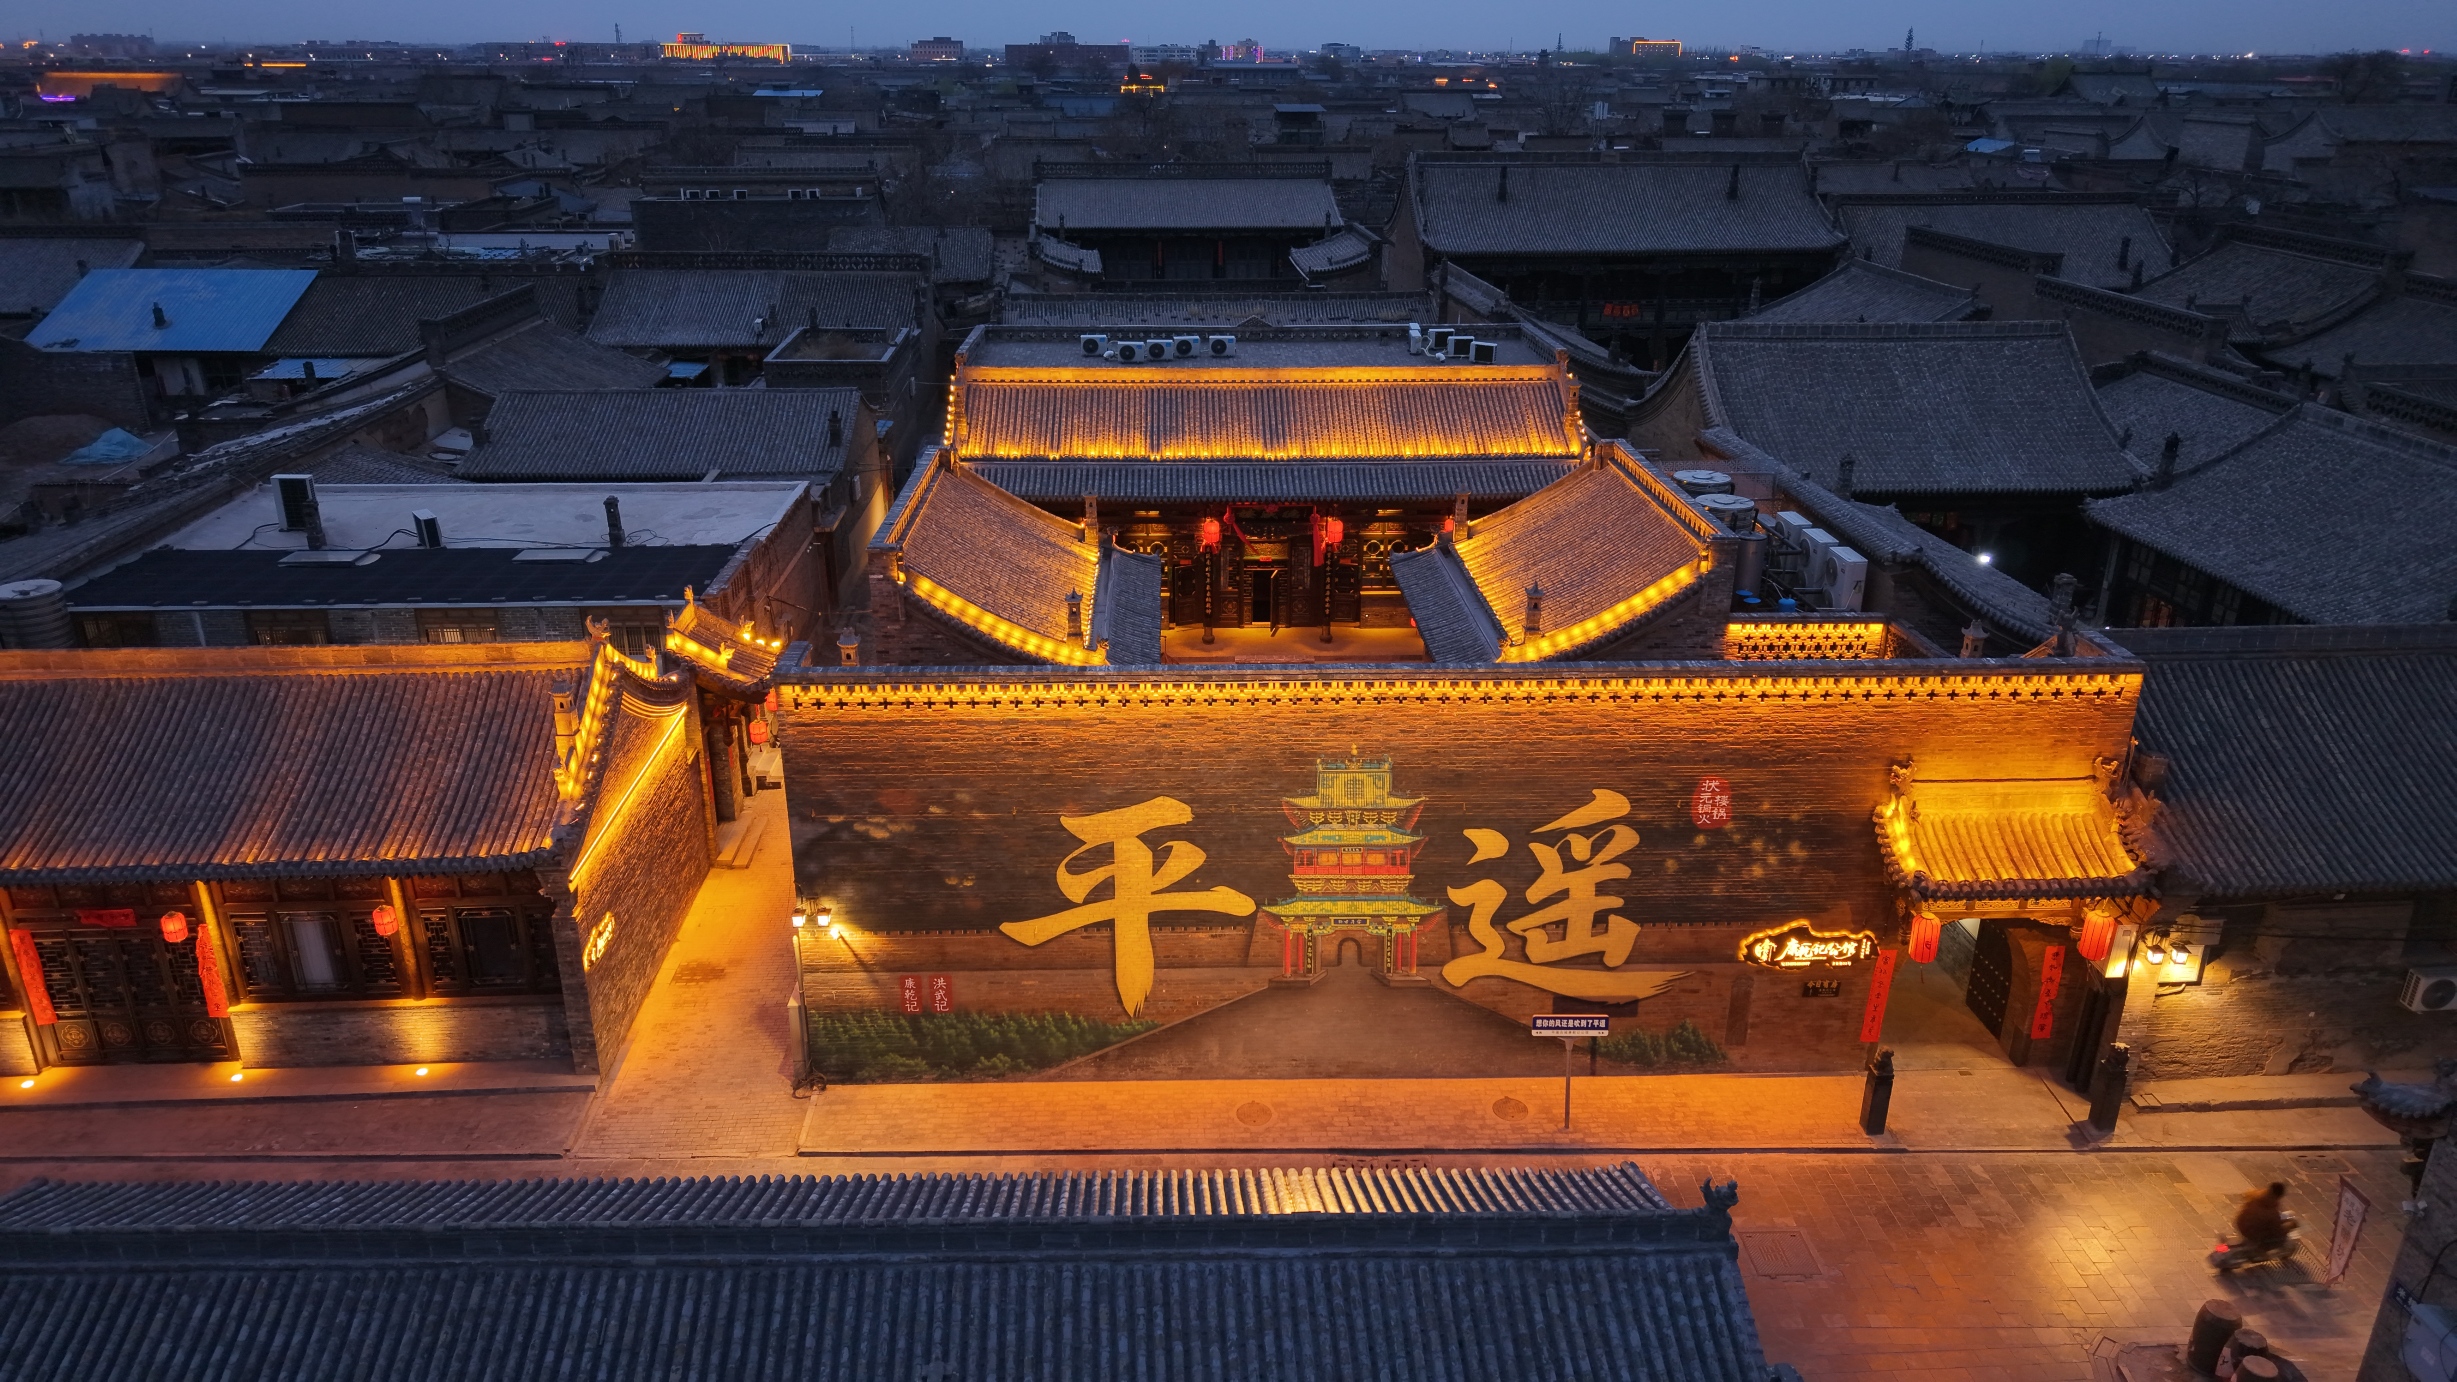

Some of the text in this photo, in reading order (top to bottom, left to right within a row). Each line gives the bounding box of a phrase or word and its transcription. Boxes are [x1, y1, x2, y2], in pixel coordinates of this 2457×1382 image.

[904, 978, 919, 1012] 康乾记
[933, 977, 949, 1011] 洪武记
